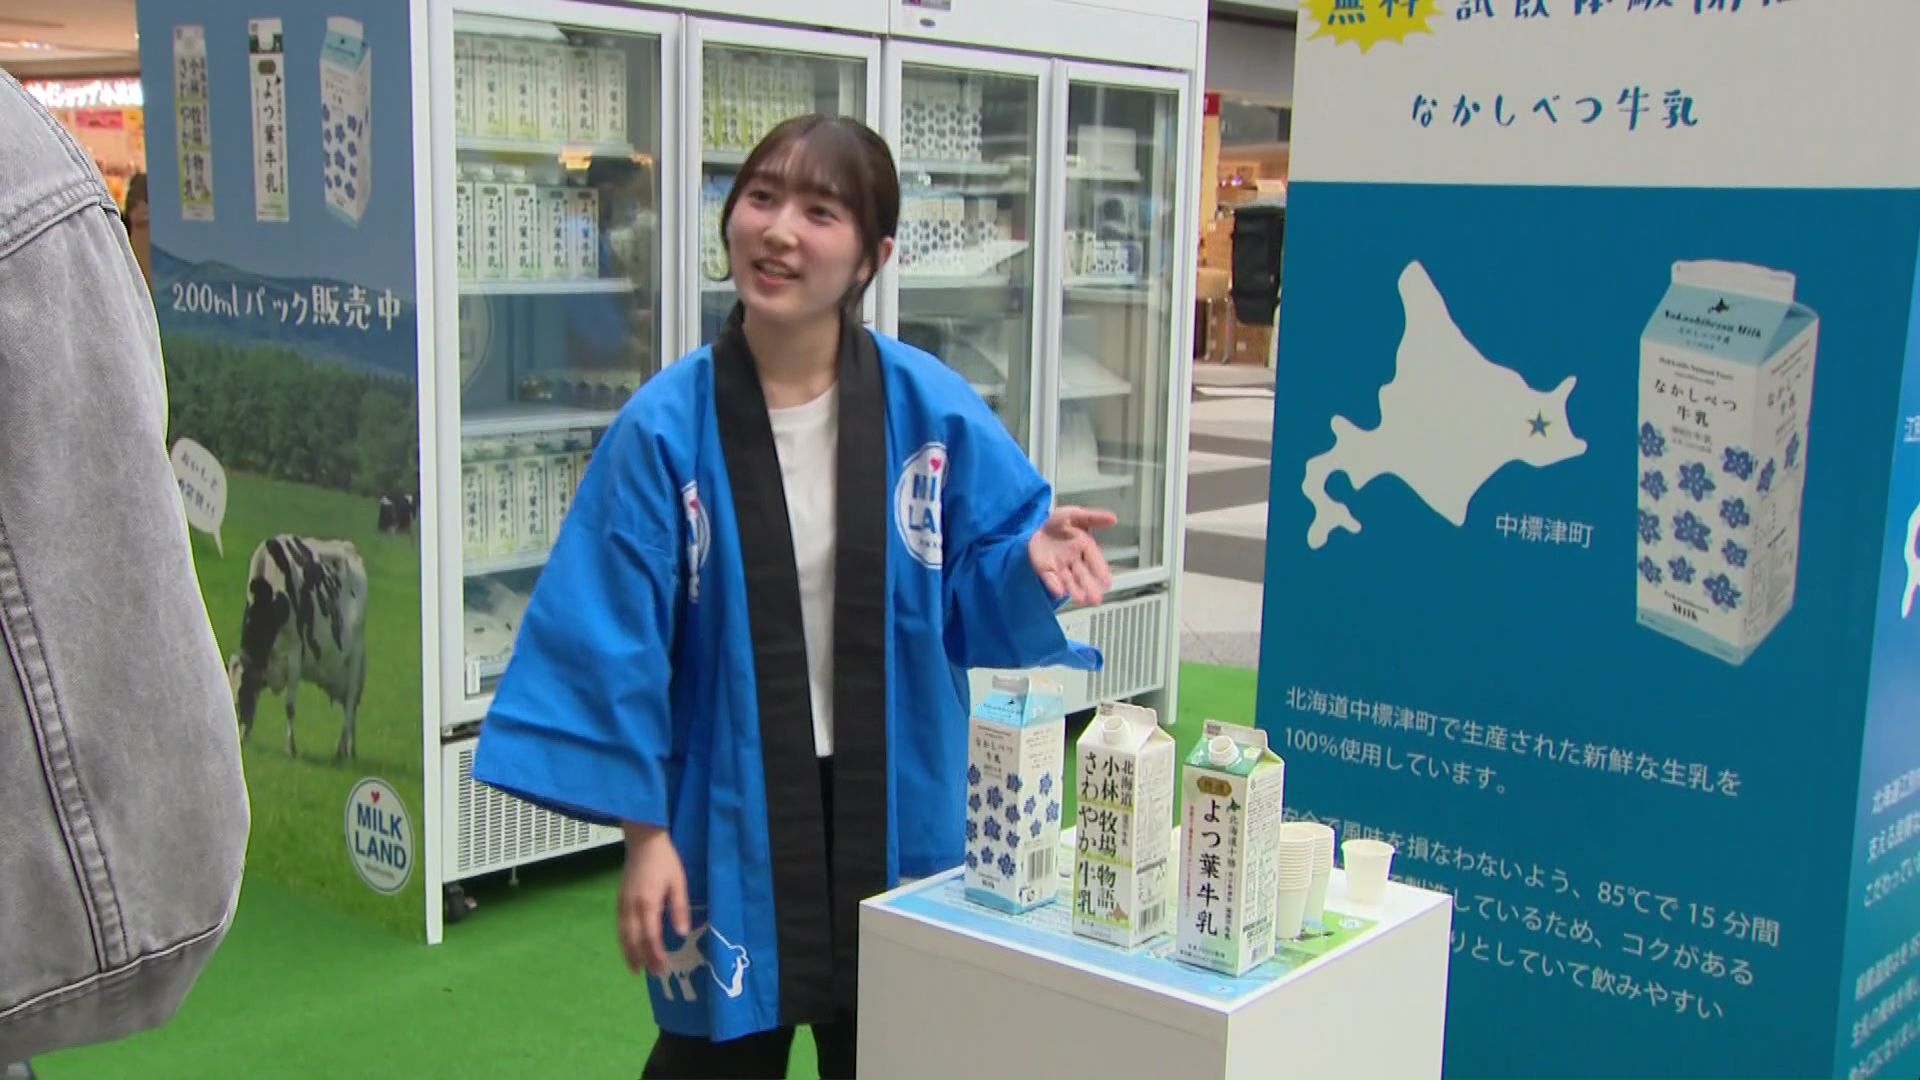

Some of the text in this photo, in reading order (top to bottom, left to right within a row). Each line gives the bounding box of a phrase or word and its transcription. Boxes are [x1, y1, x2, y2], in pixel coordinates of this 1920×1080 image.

[1411, 86, 1699, 131] なかしべつ牛乳
[1495, 512, 1594, 549] 中標津町
[1284, 726, 1506, 796] 100%使用しています。
[1286, 686, 1742, 798] 北海道中標津町で生産された新鮮な生乳を
[357, 802, 402, 840] MILK
[1078, 752, 1099, 916] さわやか牛乳
[355, 830, 406, 870] LAND
[1196, 799, 1221, 937] よつ葉牛乳
